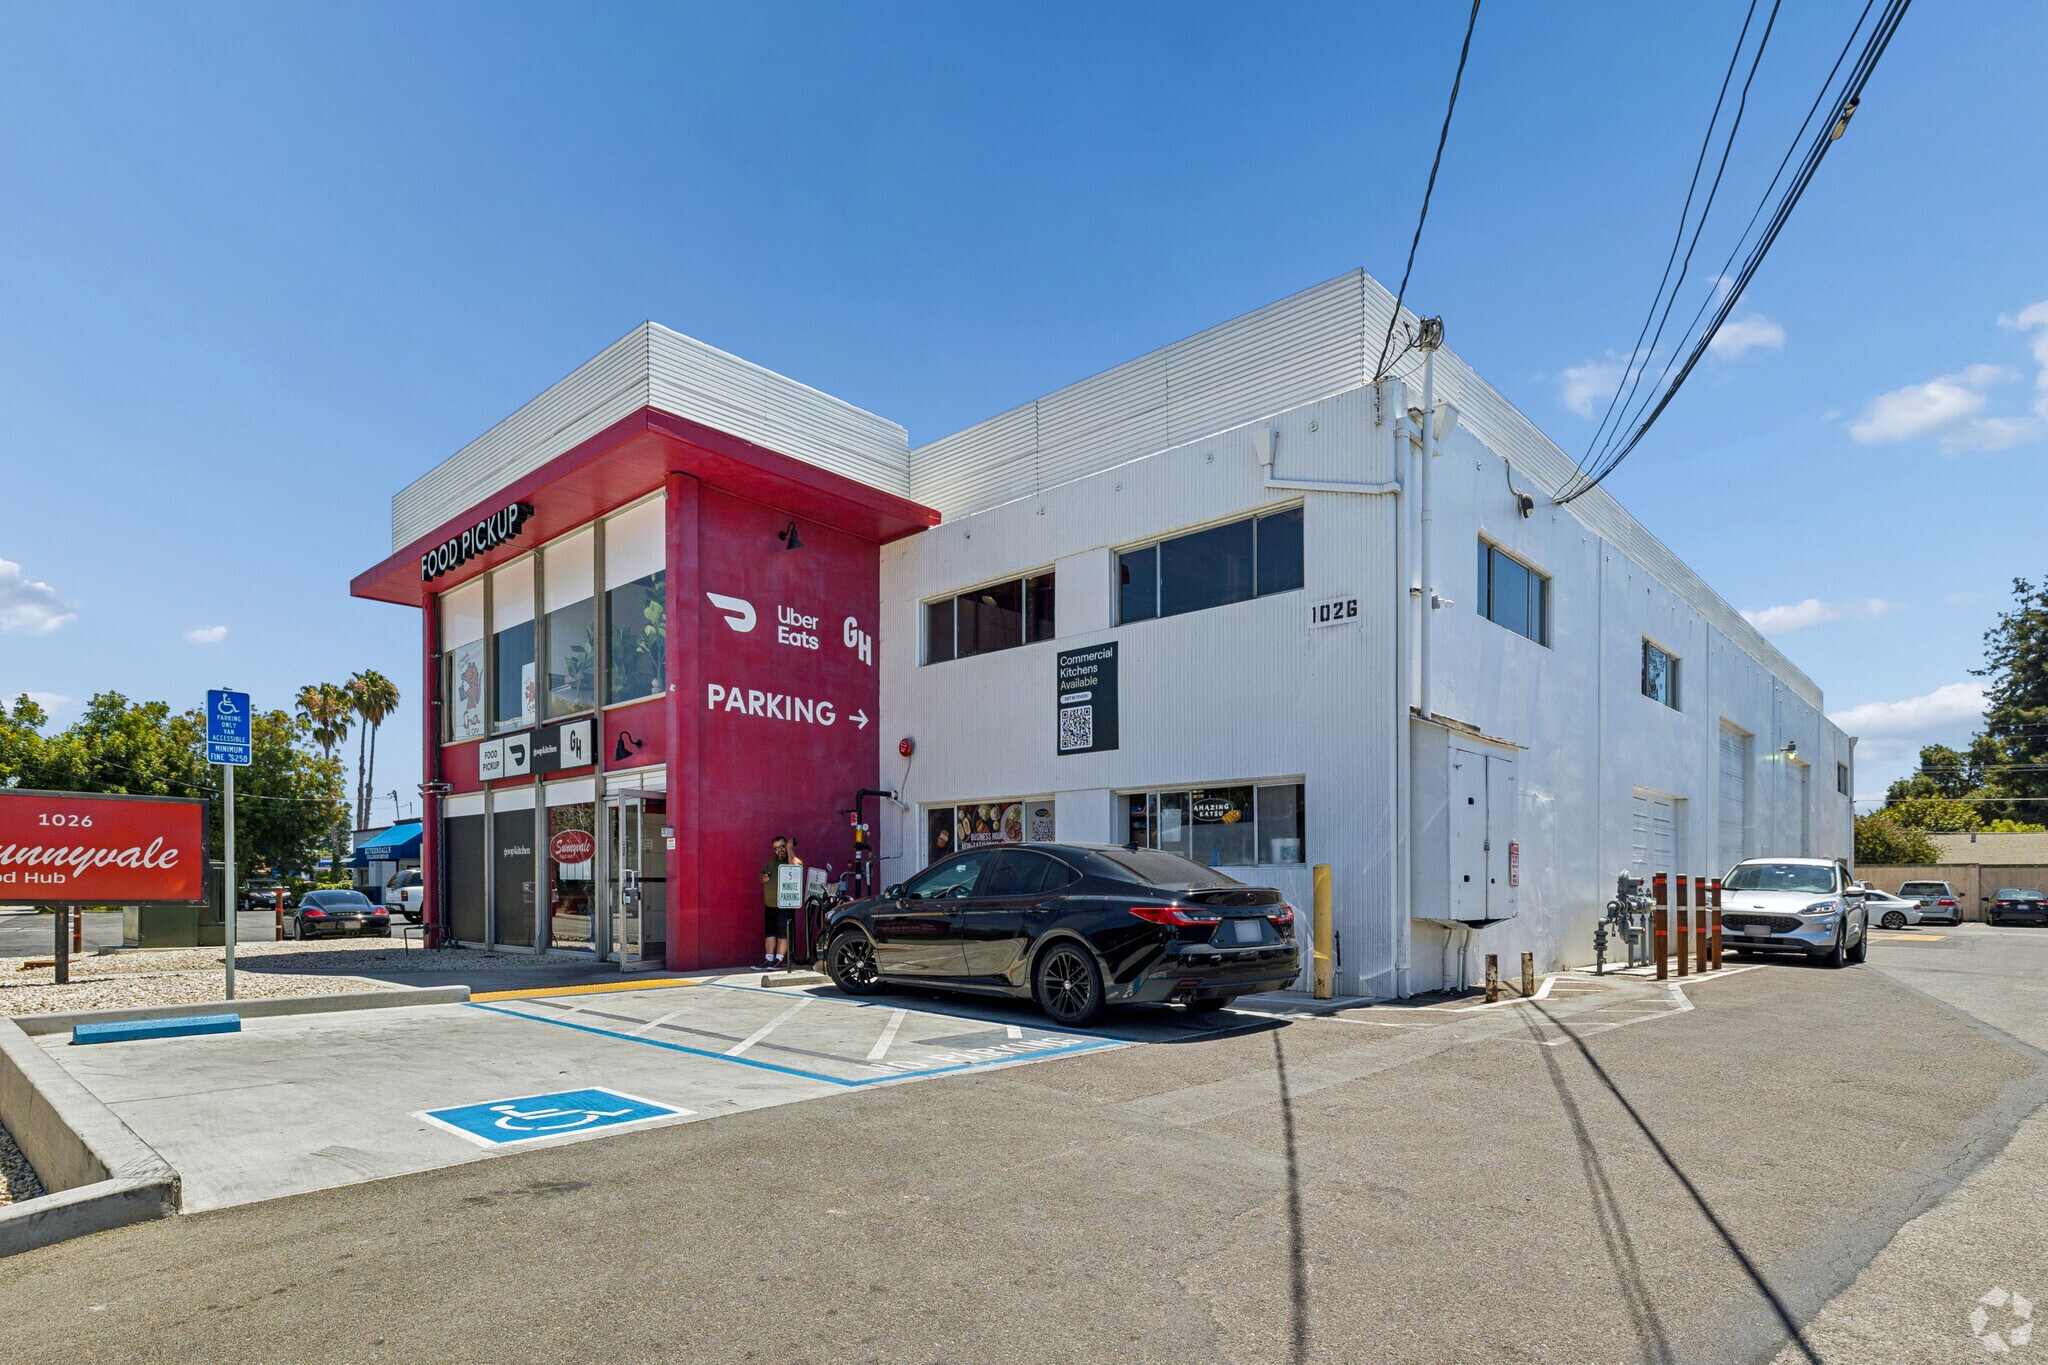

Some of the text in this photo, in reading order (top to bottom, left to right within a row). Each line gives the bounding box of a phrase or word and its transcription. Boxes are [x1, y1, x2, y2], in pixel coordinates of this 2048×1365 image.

[421, 503, 518, 581] FOOD PICKUP
[777, 604, 819, 630] Uber
[1312, 599, 1358, 624] 1026
[777, 625, 820, 650] Eats
[1060, 647, 1113, 666] Commercial
[1060, 664, 1098, 679] Kitchens
[1060, 676, 1098, 691] Available
[708, 683, 836, 726] PARKING
[216, 714, 242, 723] PARKING
[221, 721, 237, 729] ONLY
[212, 734, 246, 743] ACCESSIBLE
[215, 745, 243, 754] MINIMUM
[484, 749, 498, 760] FOOD
[210, 753, 248, 763] FINE $250
[482, 760, 500, 772] PICKUP
[1193, 803, 1230, 811] AMAZING
[38, 813, 93, 828] 1026
[555, 837, 592, 855] Sunnyvale
[24, 872, 66, 884] Hub
[788, 871, 793, 881] 5
[782, 882, 799, 891] MINUTE
[780, 892, 800, 901] PARKING
